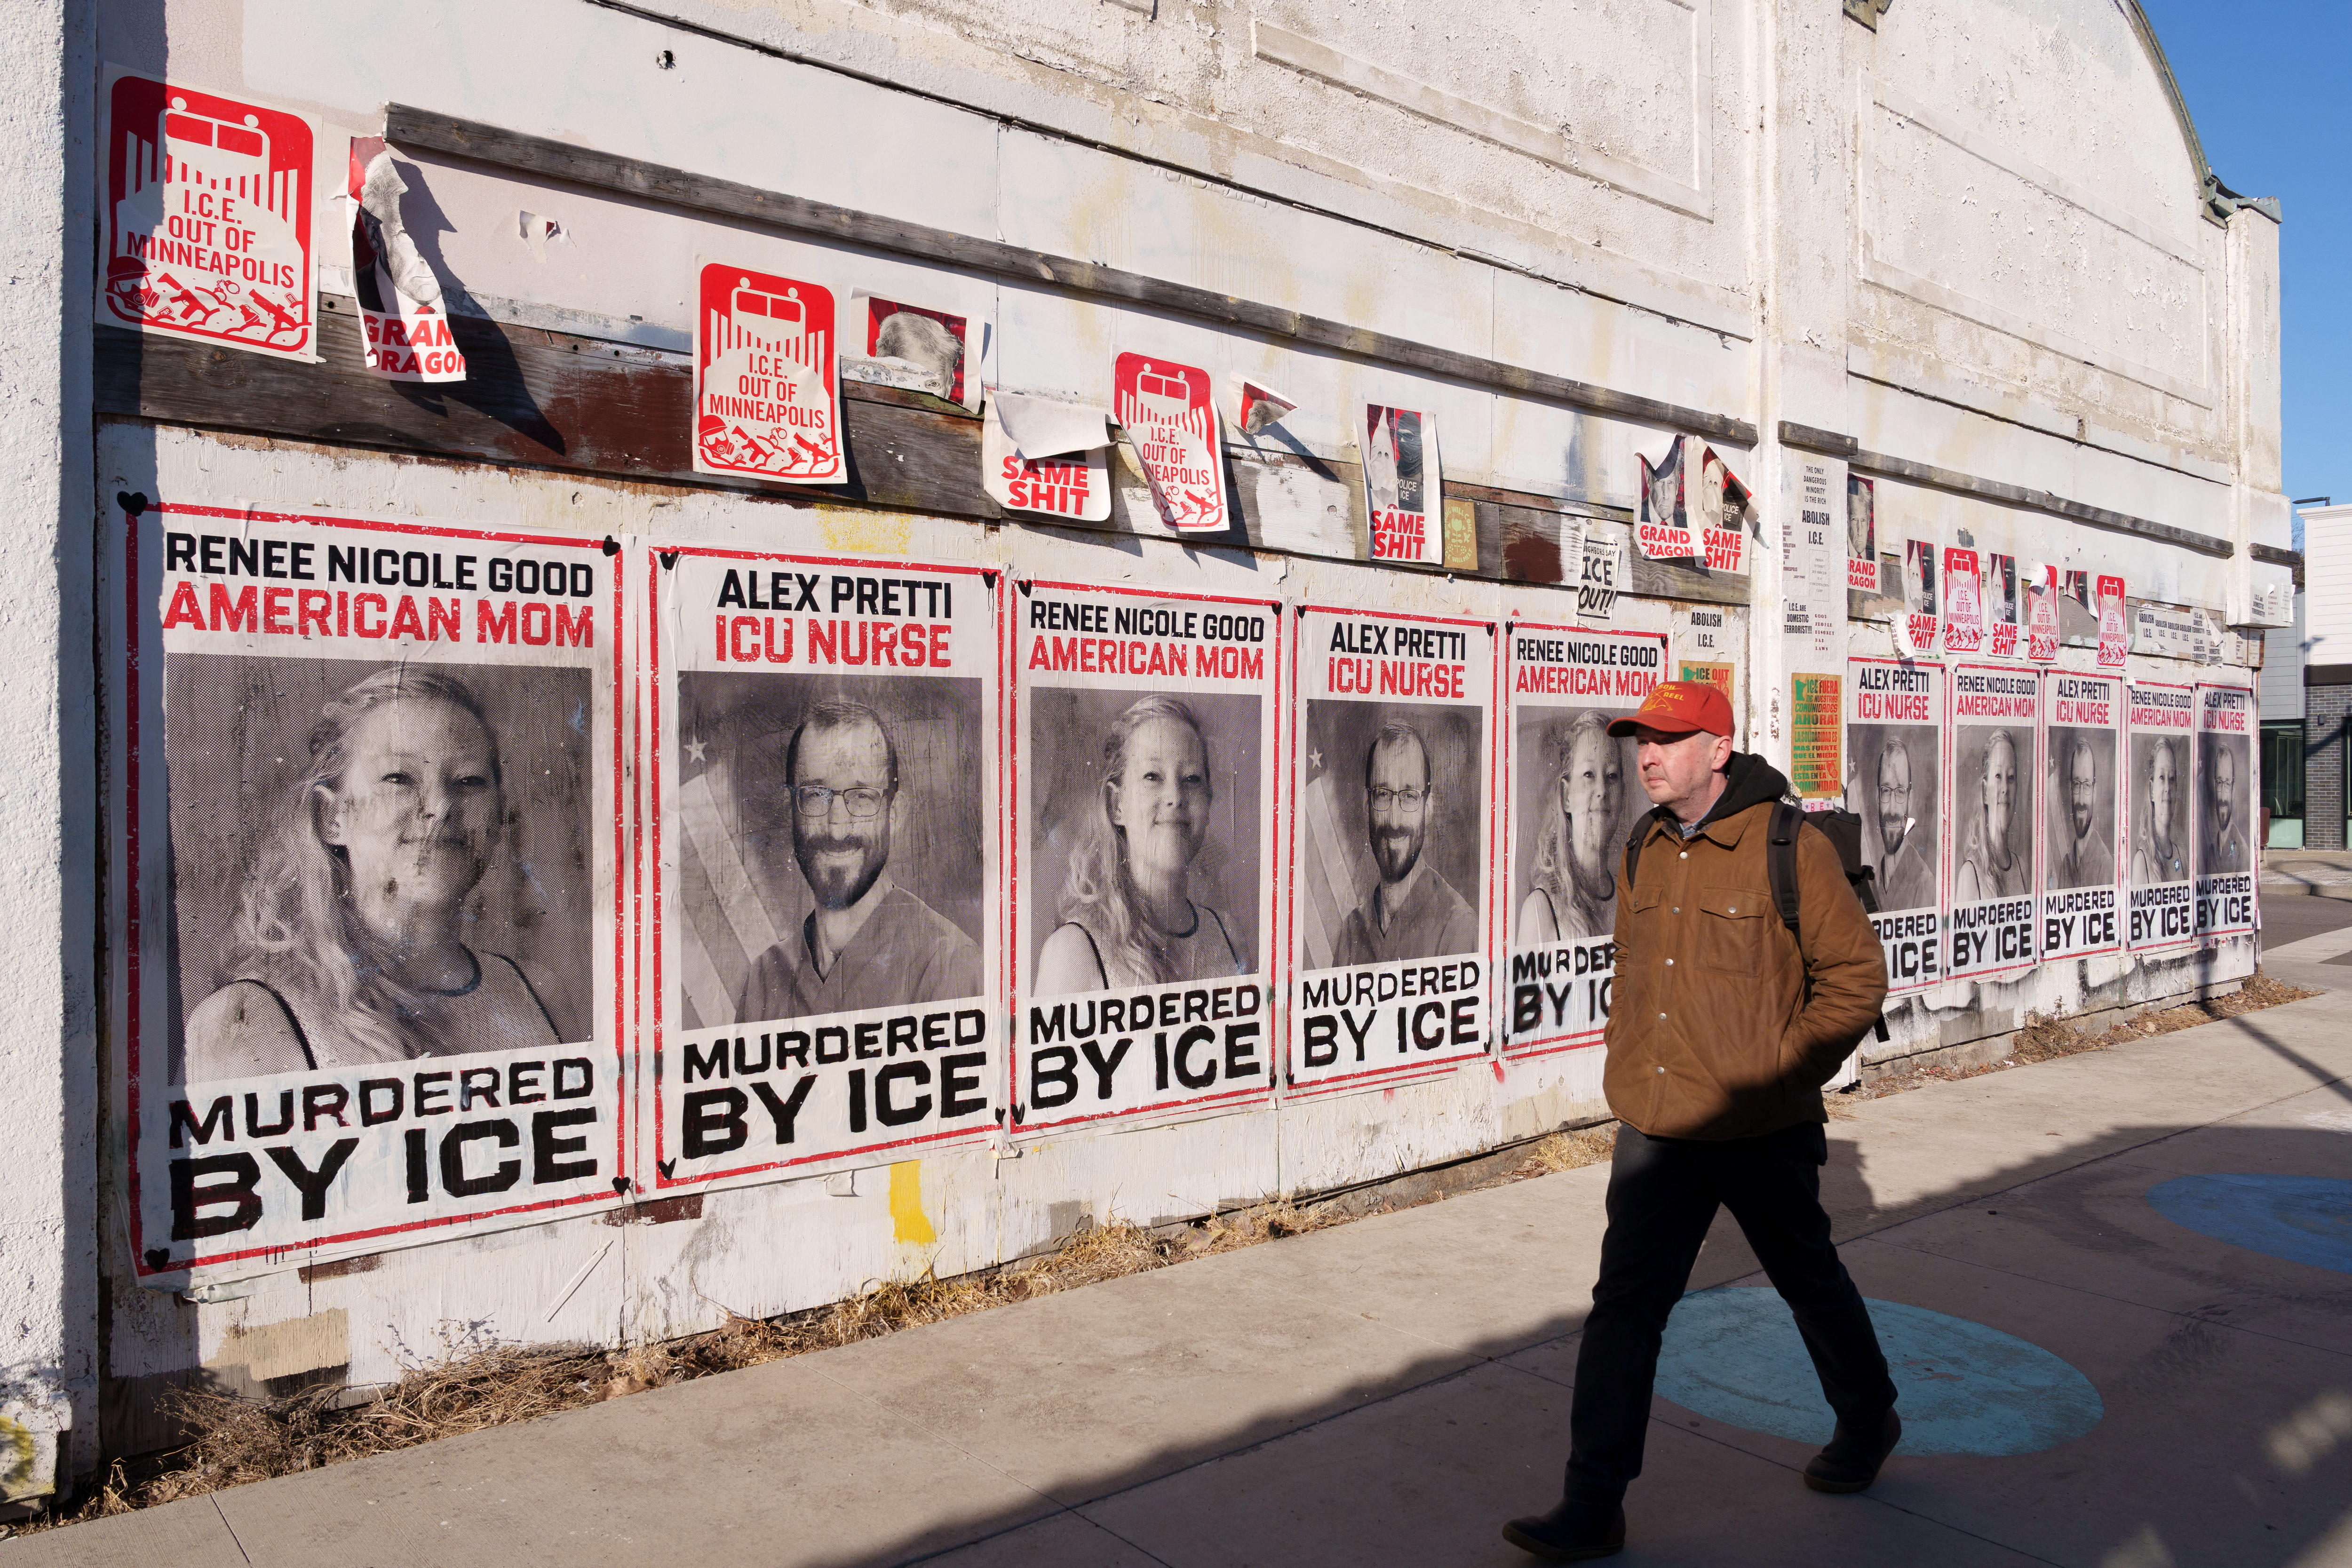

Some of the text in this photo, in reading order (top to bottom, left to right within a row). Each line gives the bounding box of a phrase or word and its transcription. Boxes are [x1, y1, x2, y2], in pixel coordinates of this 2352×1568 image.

[184, 189, 242, 224] I.C.E.
[168, 215, 256, 253] OUT OF
[127, 231, 294, 289] MINNEAPOLIS
[749, 353, 787, 379] I.C.E.
[739, 375, 797, 402] OUT OF
[710, 393, 825, 429] MINNEAPOLIS
[1150, 426, 1179, 445] I.C.E.
[1143, 443, 1186, 464] OUT OF
[1001, 455, 1088, 488] SAME
[1804, 476, 1827, 486] DANGEROUS
[1008, 481, 1089, 515] SHIT
[1806, 486, 1825, 494] MINORITY
[1370, 510, 1425, 535] SAME
[1452, 506, 1464, 517] WILL
[1802, 510, 1829, 525] ABOLISH
[1372, 532, 1425, 559] SHIT
[1640, 525, 1690, 544] GRAND
[1703, 528, 1741, 550] SAME
[1809, 531, 1824, 545] I.C.E.
[167, 532, 593, 598] RENEE NICOLE GOOD
[1703, 546, 1741, 571] SHIT
[1581, 556, 1612, 586] ICE
[717, 569, 951, 618] ALEX PRETTI
[1578, 585, 1614, 614] OUT!
[1958, 590, 1969, 601] I.C.E.
[163, 581, 593, 648] AMERICAN MOM
[1787, 614, 1809, 622] DOMESTIC
[1789, 603, 1799, 611] I.C.E.
[1956, 601, 1971, 612] OUT OF
[2046, 614, 2050, 623] OF
[2139, 613, 2154, 623] ABOLISH
[1031, 600, 1264, 642] RENEE NICOLE GOOD
[1691, 612, 1722, 627] ABOLISH
[1784, 625, 1812, 634] TERRORIST!!!
[1908, 614, 1937, 631] SAME
[1949, 613, 1979, 625] MINNEAPOLIS
[1993, 623, 2017, 638] SAME
[2032, 624, 2056, 635] MINNEAPOLIS
[716, 614, 951, 667] ICU NURSE
[1330, 622, 1465, 661] ALEX PRETTI
[1698, 634, 1714, 648] I.C.E.
[2101, 632, 2124, 643] MINNEAPOLIS
[2144, 628, 2152, 638] I.C.E.
[1028, 635, 1263, 680] AMERICAN MOM
[1518, 638, 1657, 667] RENEE NICOLE GOOD
[1992, 638, 2017, 655] SHIT
[1328, 657, 1465, 698] ICU NURSE
[1516, 665, 1657, 697] AMERICAN MOM
[1696, 668, 1729, 681] ICE OUT
[1807, 679, 1838, 694] ICE FUERA
[1859, 668, 1929, 692] ALEX PRETTI
[1958, 676, 2035, 695] RENEE NICOLE GOOD
[2057, 679, 2109, 701] ALEX PRETTI
[2131, 690, 2191, 709] RENEE NICOLE GOOD
[2205, 691, 2245, 710] ALEX PRETTI
[1795, 703, 1837, 713] COMUNIDADES
[1858, 693, 1929, 720] ICU NURSE
[1956, 695, 2035, 718] AMERICAN MOM
[2056, 700, 2109, 724] ICU NURSE
[2130, 707, 2191, 728] AMERICAN MOM
[2203, 709, 2245, 731] ICU NURSE
[1795, 731, 1837, 742] LA SOLIDARIDAD ES
[2130, 885, 2190, 908] MURDERED
[2196, 876, 2250, 897] MURDERED
[1954, 900, 2032, 929] MURDERED
[2046, 890, 2114, 915] MURDERED
[2196, 895, 2251, 929] BY ICE
[2046, 911, 2114, 950] BY ICE
[2130, 905, 2190, 941] BY ICE
[1953, 923, 2032, 967] BY ICE
[1892, 939, 1937, 979] ICE
[1303, 961, 1479, 1010] MURDERED
[1031, 984, 1260, 1045] MURDERED
[1513, 982, 1573, 1034] BY
[1304, 996, 1479, 1068] BY ICE
[683, 1009, 985, 1083] MURDERED
[1031, 1022, 1261, 1110] BY ICE
[169, 1057, 594, 1149] MURDERED
[683, 1051, 987, 1160] BY ICE
[169, 1106, 597, 1242] BY ICE
